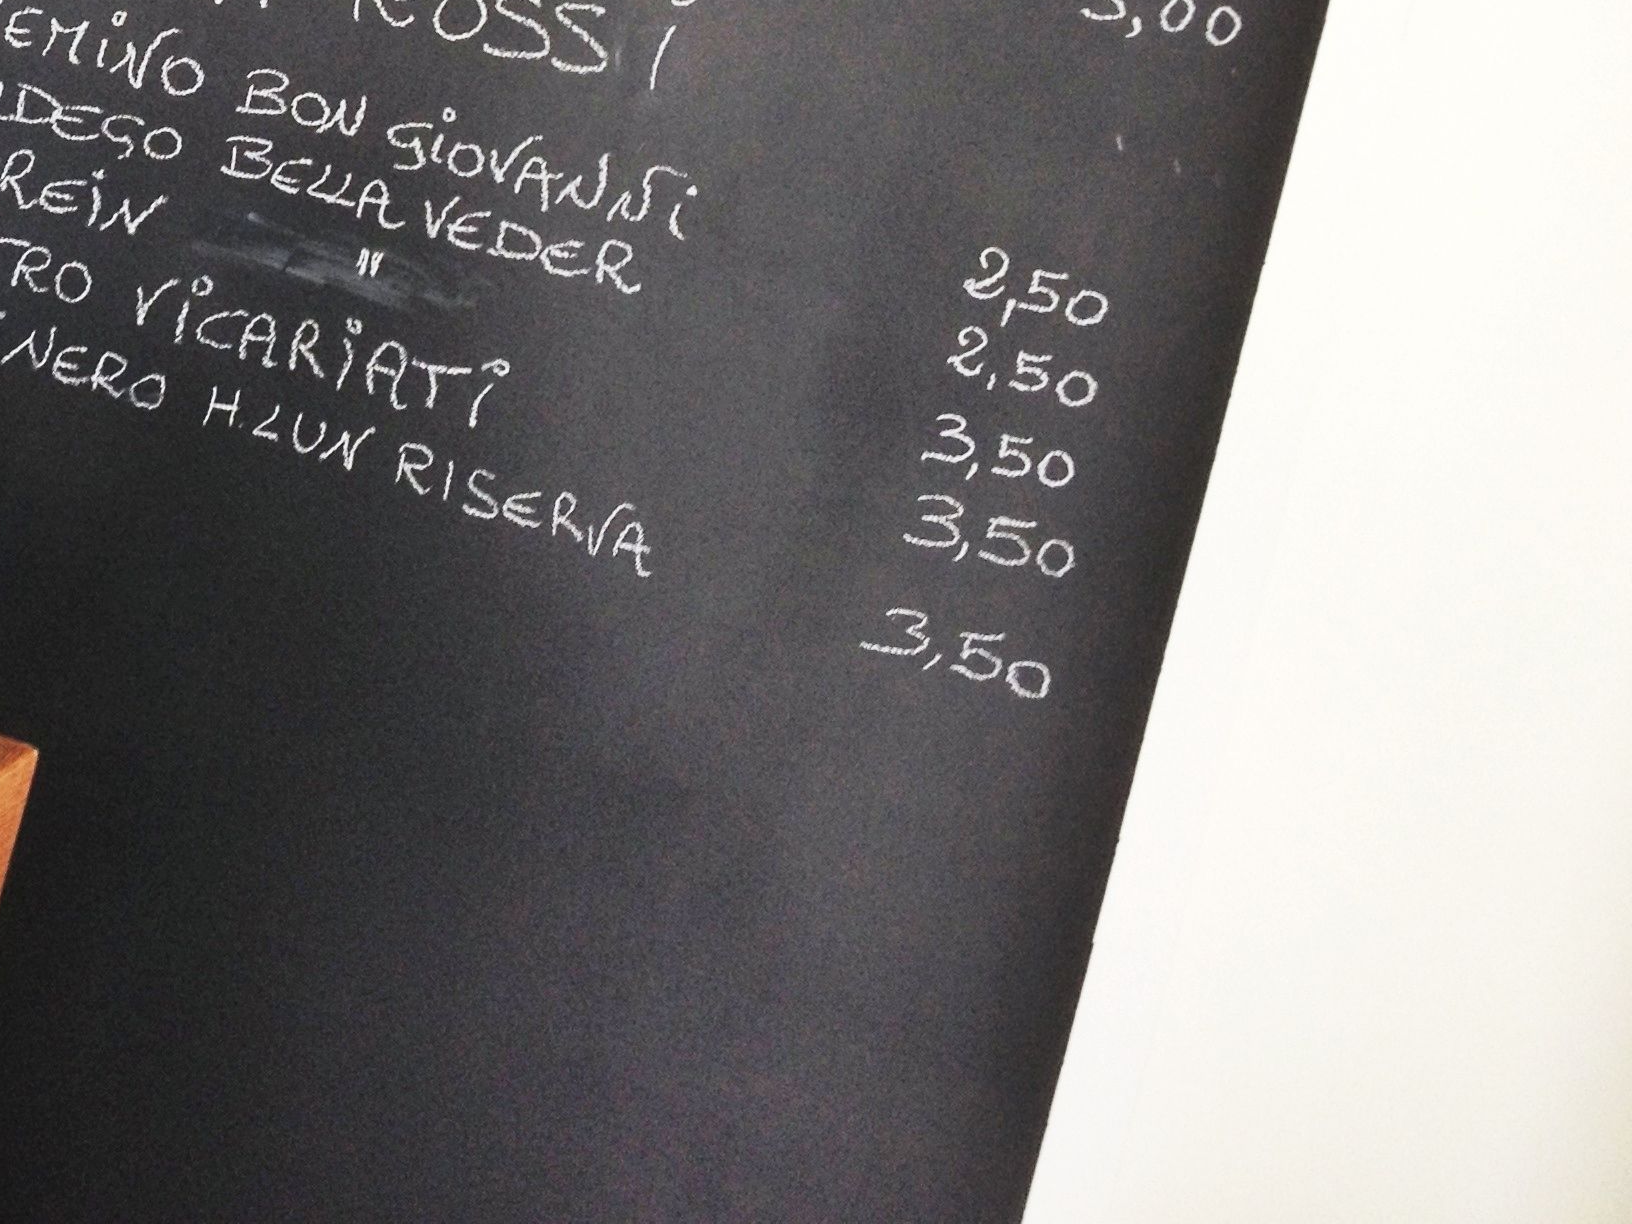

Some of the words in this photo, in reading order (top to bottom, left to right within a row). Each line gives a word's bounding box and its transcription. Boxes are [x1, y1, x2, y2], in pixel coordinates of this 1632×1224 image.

[220, 136, 406, 231] BELLA
[424, 196, 642, 295] VEDER
[947, 325, 1098, 407] 2,50
[237, 69, 367, 136] BON
[963, 246, 1109, 327] 2,50
[0, 326, 165, 411] NERO
[395, 443, 652, 577] RISERVA
[859, 608, 1051, 700] 3,50
[902, 494, 1076, 577] 3,50
[921, 413, 1076, 488] 3,50
